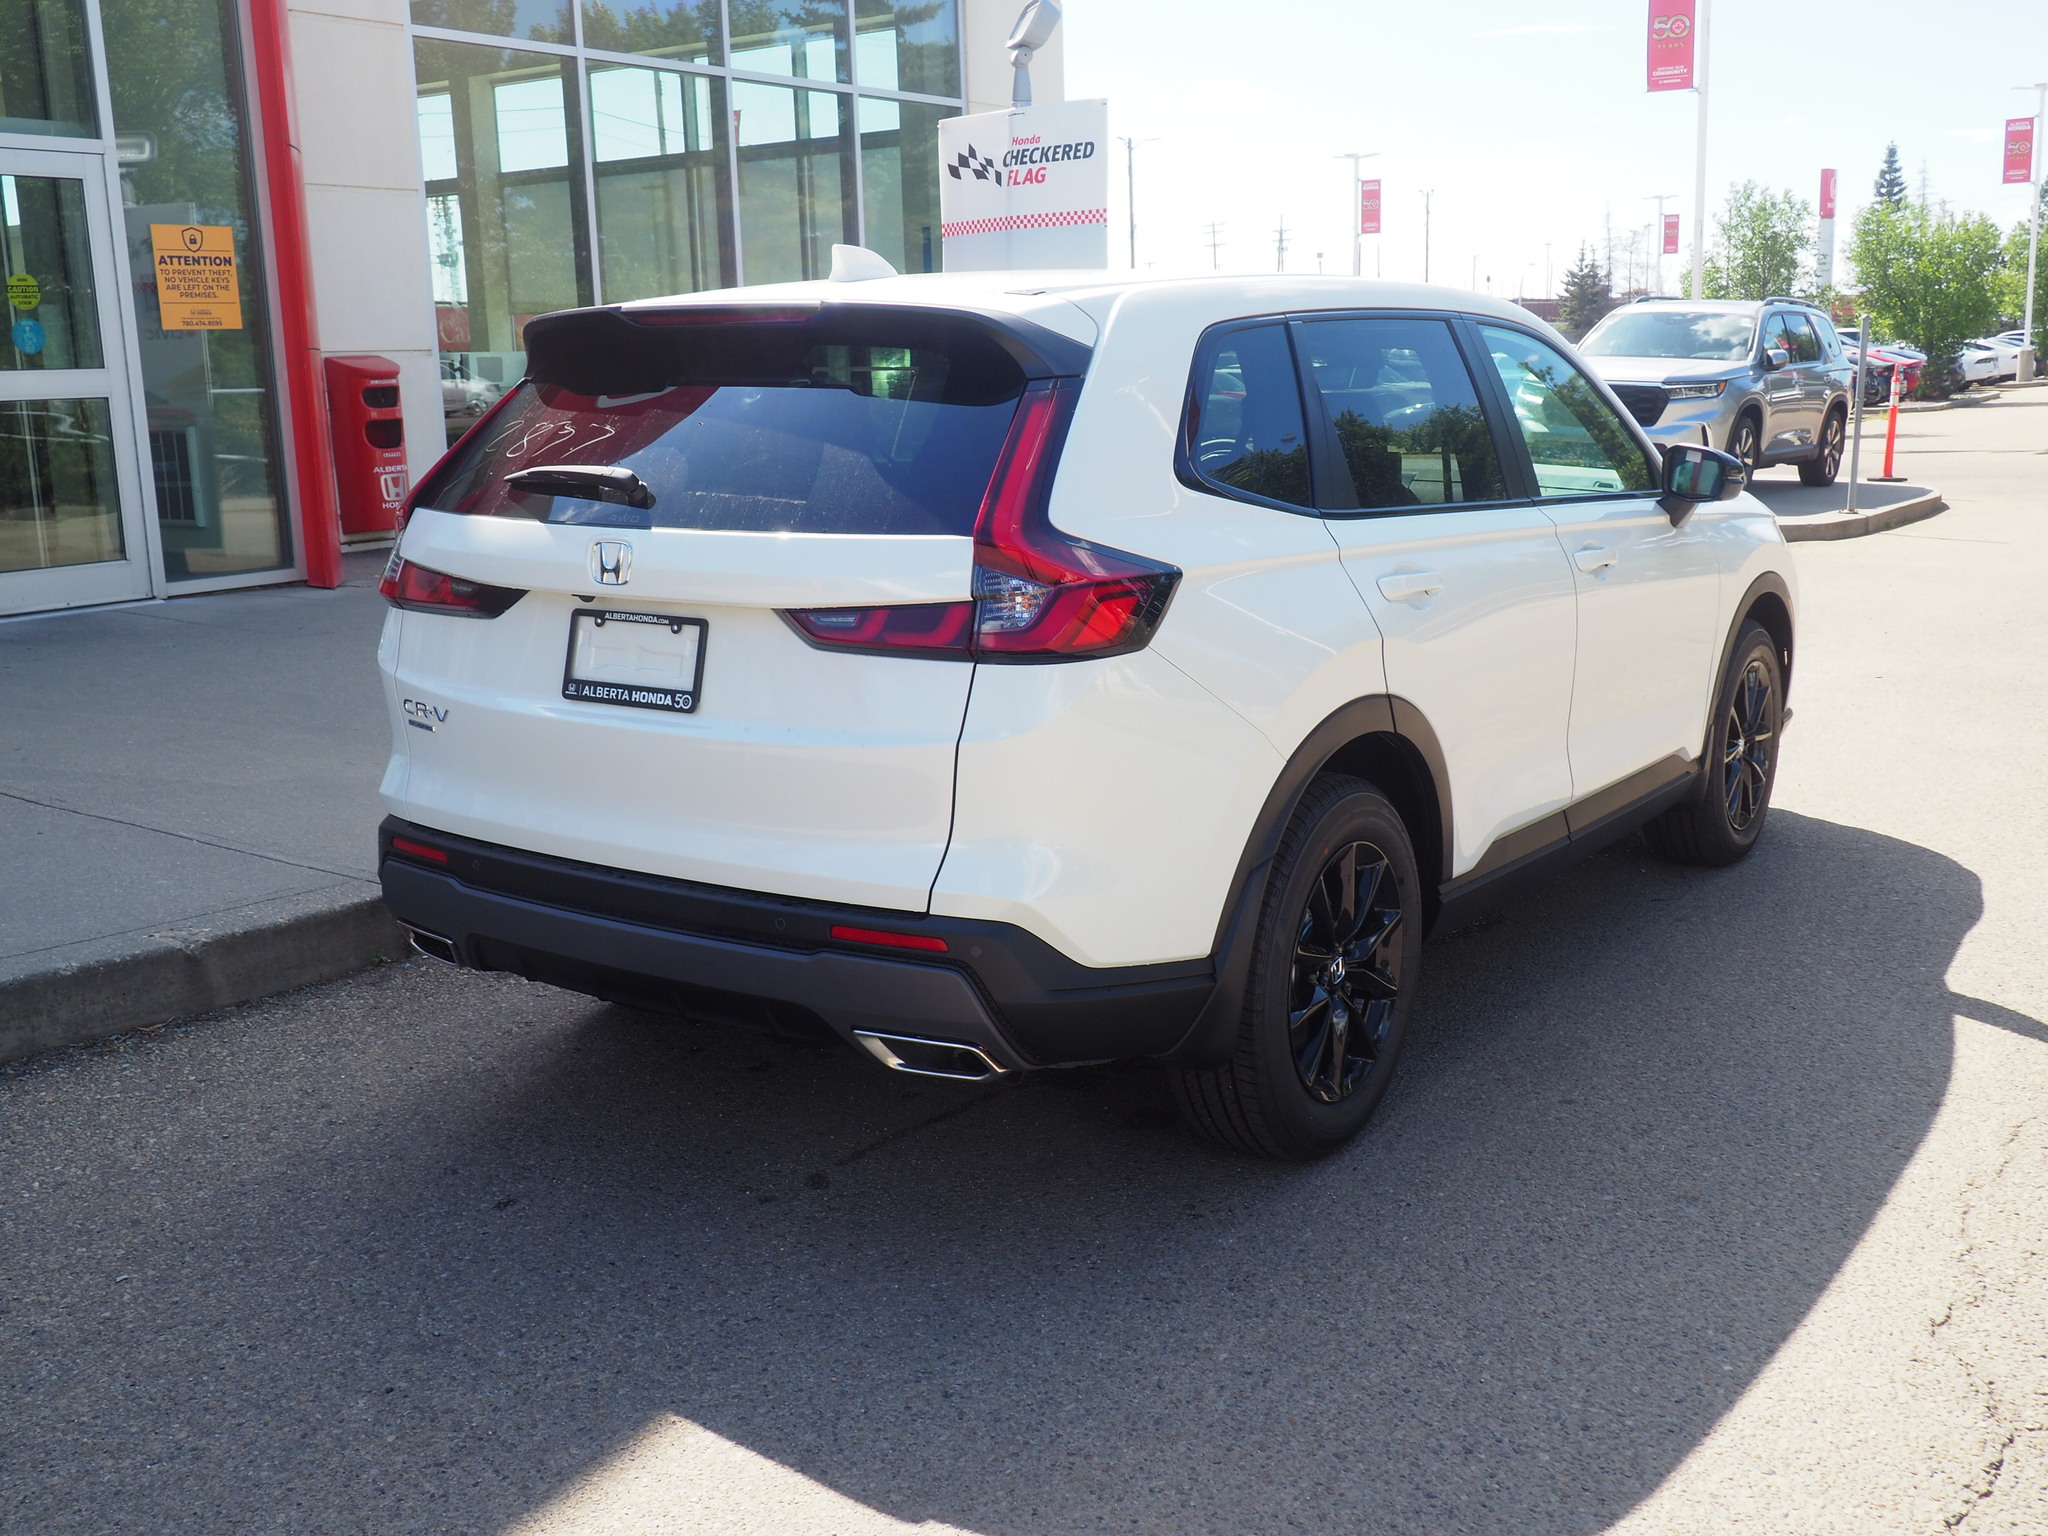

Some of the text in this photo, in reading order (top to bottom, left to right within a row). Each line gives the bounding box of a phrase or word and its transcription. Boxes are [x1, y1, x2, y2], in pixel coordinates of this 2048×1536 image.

[1652, 14, 1690, 41] 50
[1011, 134, 1041, 146] Honda
[1002, 141, 1095, 168] CHECKERED
[1007, 166, 1047, 187] FLAG
[158, 255, 232, 267] ATTENTION
[608, 514, 641, 523] AWD
[582, 685, 692, 709] ALBERTA HONDA 50
[403, 699, 448, 722] CR-V
